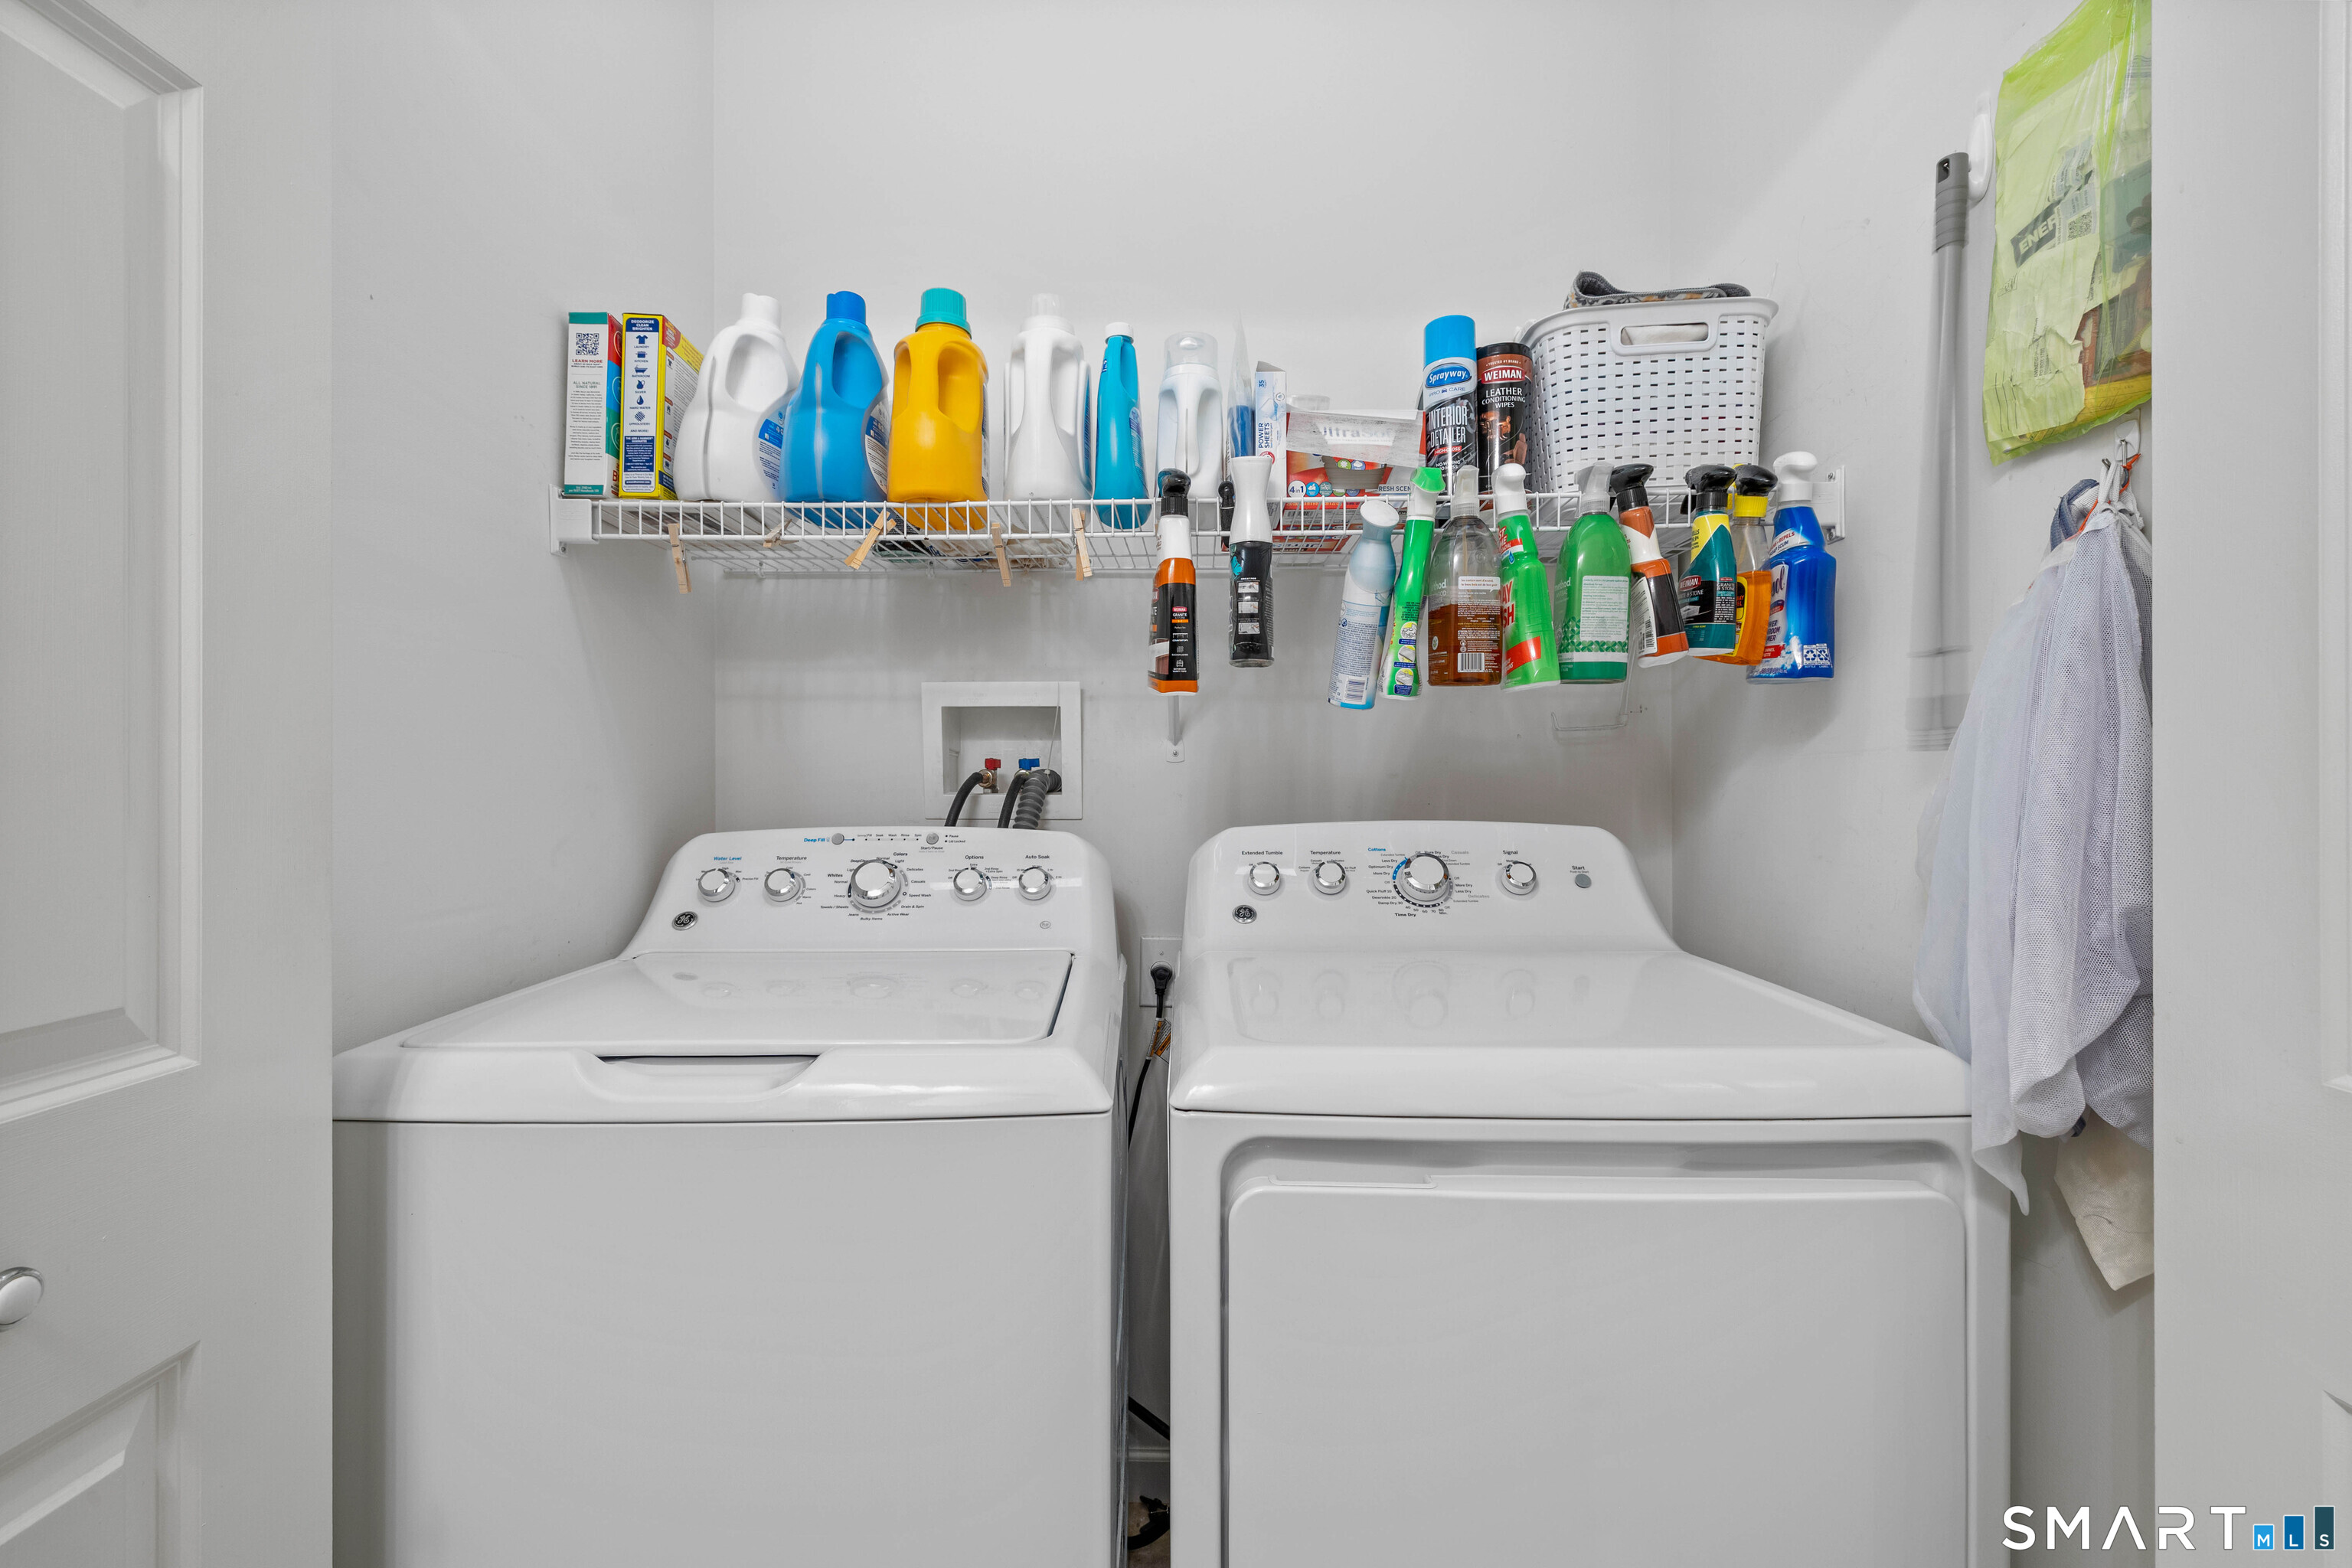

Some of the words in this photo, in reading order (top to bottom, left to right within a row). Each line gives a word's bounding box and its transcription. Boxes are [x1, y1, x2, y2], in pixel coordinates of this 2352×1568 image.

[1429, 371, 1466, 384] Sprayway
[1484, 369, 1522, 381] WEIMAN
[1486, 387, 1522, 398] LEATHER
[1482, 396, 1526, 405] CONDITIONING
[1429, 405, 1467, 431] INTERIOR
[1778, 540, 1789, 550] SCUM
